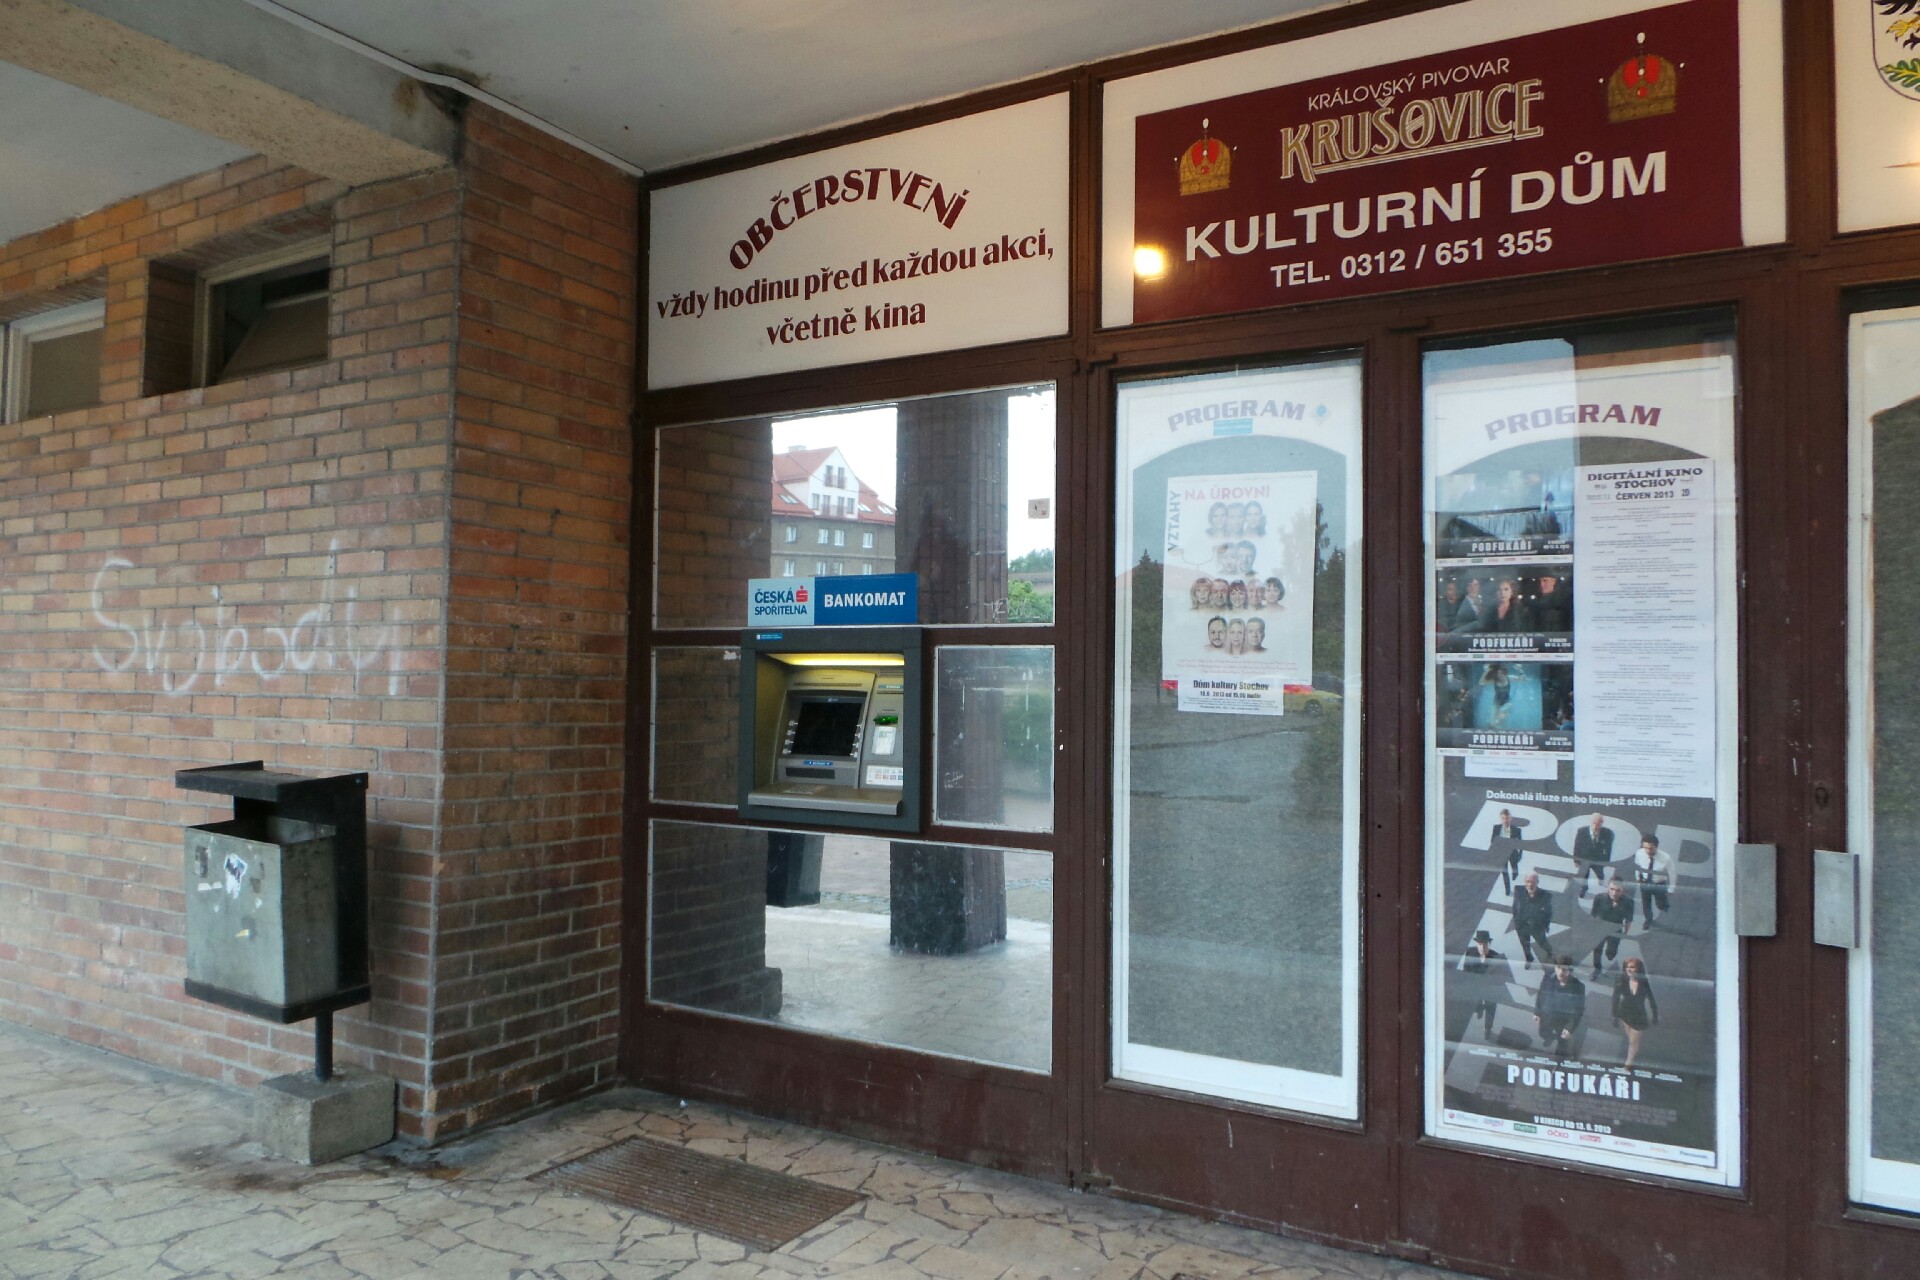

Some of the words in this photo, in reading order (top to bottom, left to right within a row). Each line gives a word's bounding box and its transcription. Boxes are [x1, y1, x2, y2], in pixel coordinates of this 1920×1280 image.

[1307, 73, 1417, 112] KRÁLOVSKÝ
[1421, 57, 1511, 89] PIVOVAR
[1280, 78, 1545, 183] KRUŠOVICE
[729, 167, 971, 270] OBČERSTVENÍ
[1185, 168, 1488, 262] KULTURNÍ
[1510, 151, 1668, 213] DŮM
[656, 290, 710, 318] vždy
[714, 276, 800, 311] hodinu
[803, 260, 868, 301] před
[873, 246, 977, 285] každou
[982, 228, 1055, 266] akcí,
[1270, 262, 1330, 287] TEL.
[1340, 248, 1406, 280] 0312
[1415, 247, 1425, 271] /
[1434, 237, 1485, 264] 651
[1498, 227, 1553, 259] 355
[766, 306, 857, 345] včetně
[864, 302, 926, 332] kina
[1168, 400, 1306, 432] PROGRAM
[1484, 403, 1662, 441] PROGRAM
[1184, 489, 1206, 500] NA
[1210, 484, 1270, 500] ÚROVNÍ
[1587, 470, 1661, 481] DIGITÁLNÍ
[1665, 468, 1703, 477] KINO
[1614, 478, 1676, 489] STOCHOV
[1616, 491, 1651, 500] ČERVEN
[1654, 490, 1674, 499] 2013
[1168, 491, 1181, 552] VZTAHY
[754, 587, 795, 604] ČESKÁ
[754, 604, 808, 615] SPOŘITELNA
[824, 592, 906, 608] BANKOMAT
[1486, 790, 1534, 801] Dokonalá
[1535, 792, 1560, 802] iluze
[1561, 794, 1587, 804] nebo
[1589, 795, 1625, 807] loupež
[1626, 796, 1667, 807] století?
[1507, 1064, 1640, 1101] PODFUKÁŘI
